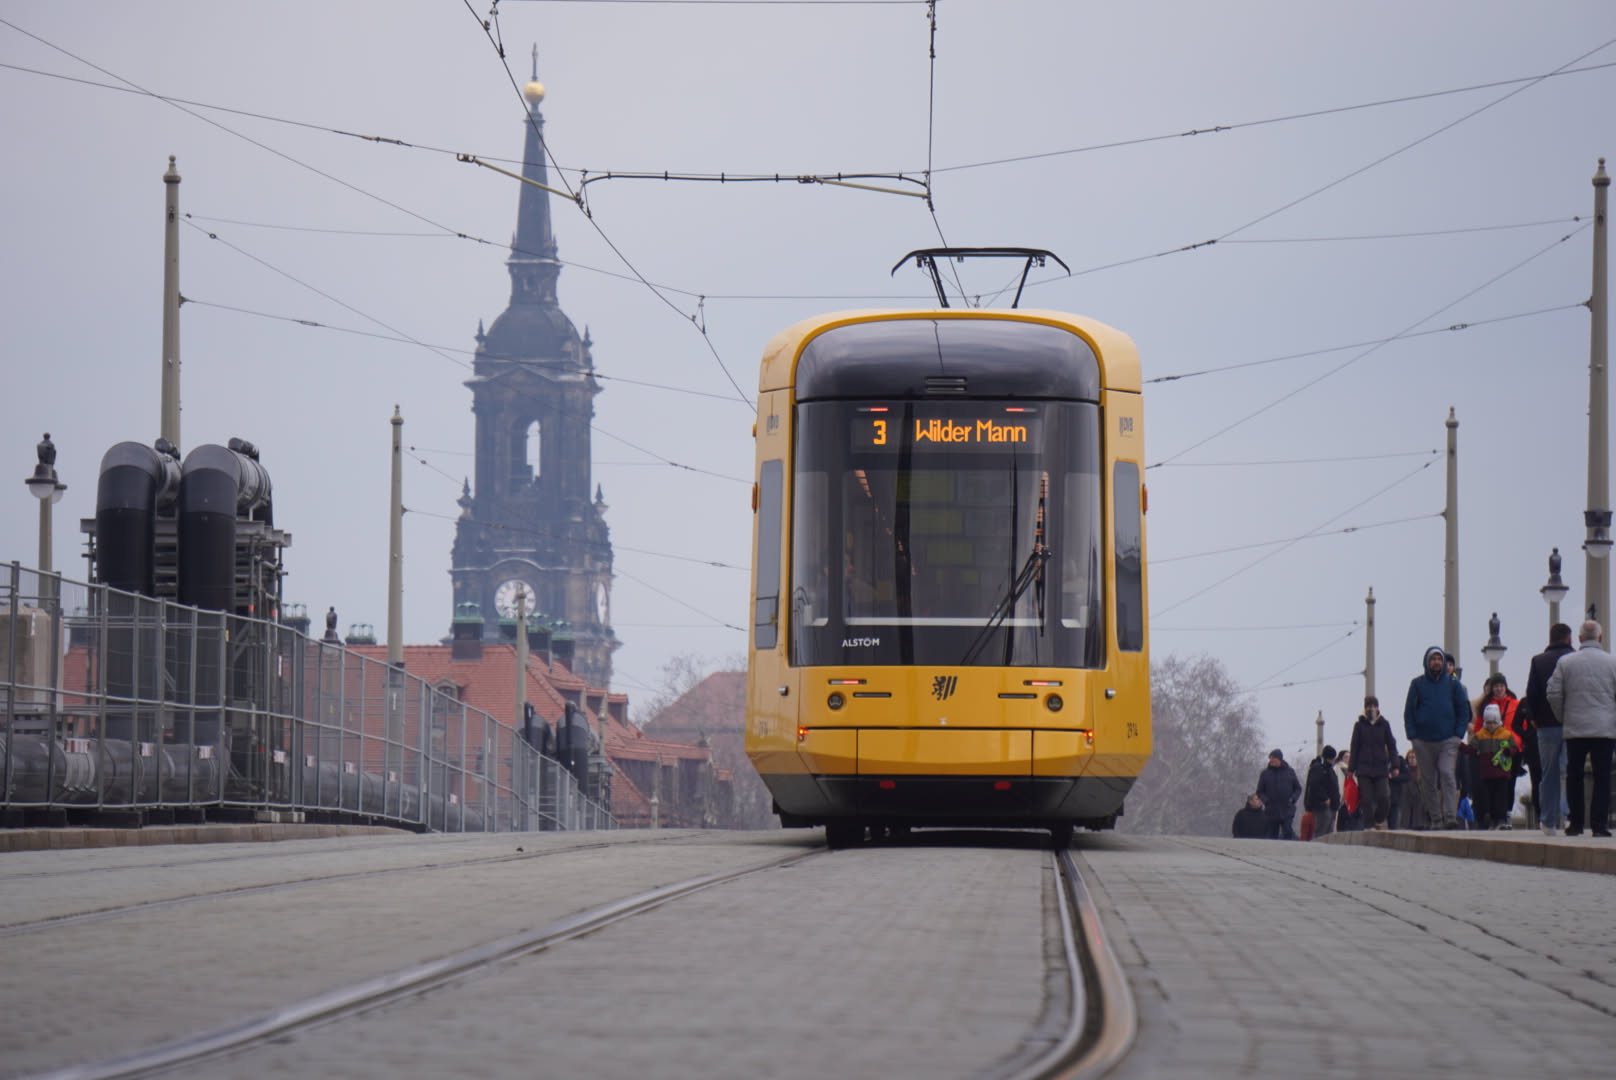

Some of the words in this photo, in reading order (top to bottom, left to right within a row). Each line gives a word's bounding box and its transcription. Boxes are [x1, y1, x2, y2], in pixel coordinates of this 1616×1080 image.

[873, 420, 887, 445] 3
[915, 419, 972, 443] Wilder
[976, 419, 1027, 443] Mann
[842, 637, 880, 648] ALSTOM
